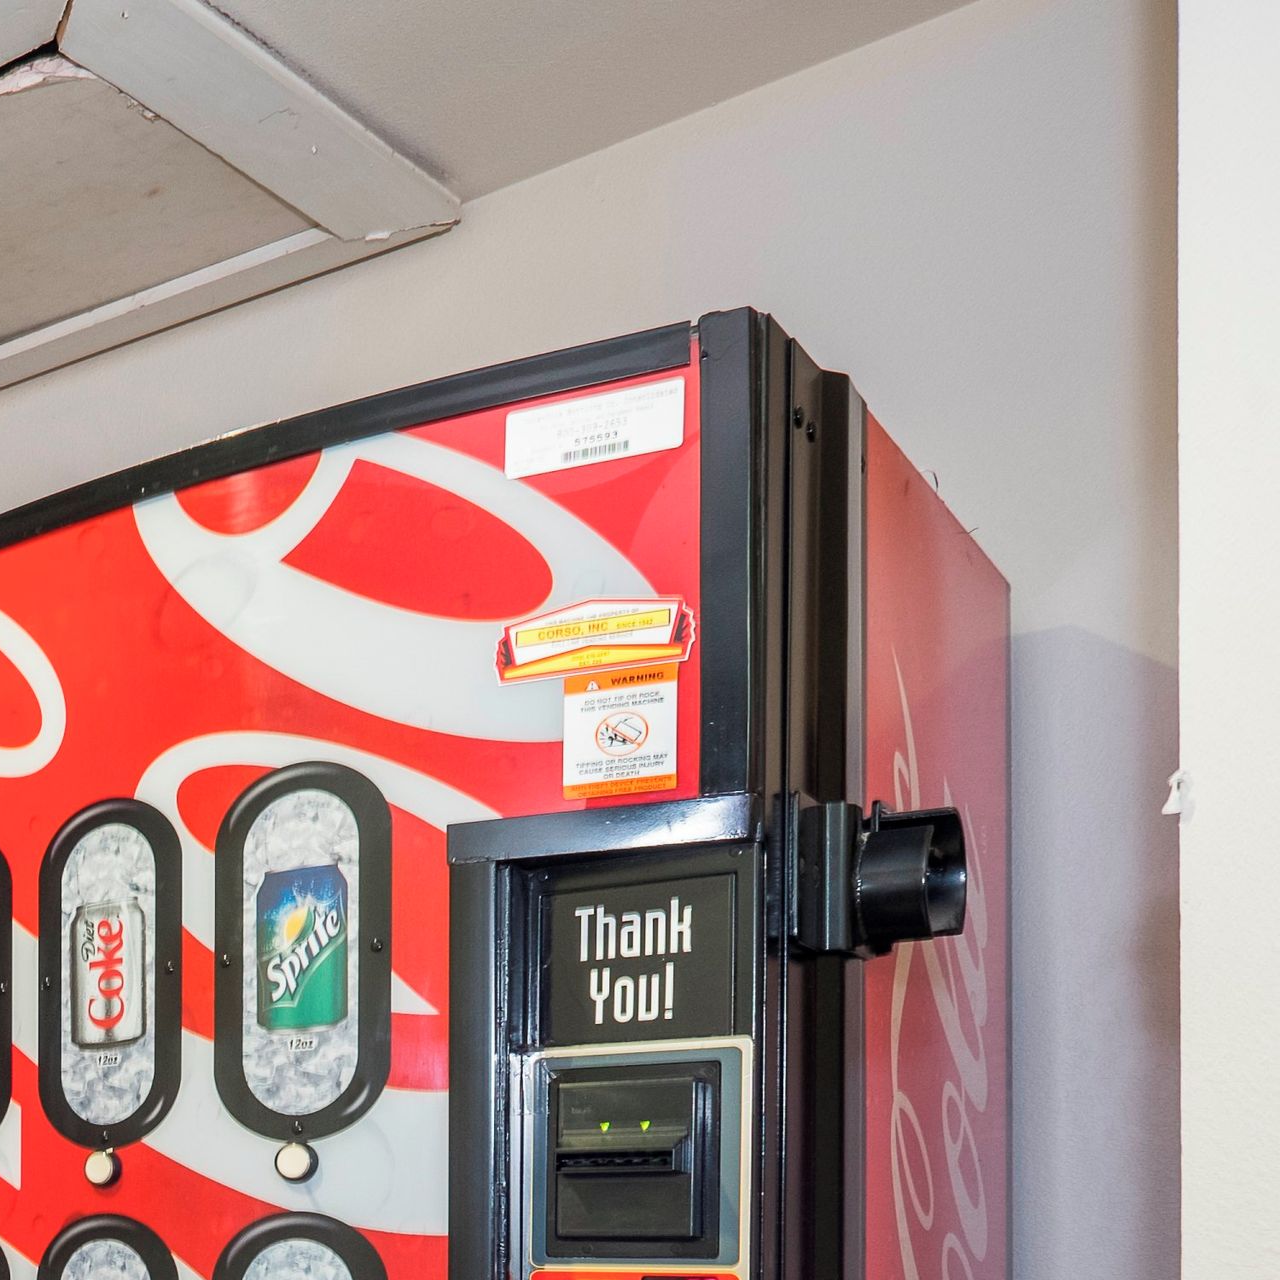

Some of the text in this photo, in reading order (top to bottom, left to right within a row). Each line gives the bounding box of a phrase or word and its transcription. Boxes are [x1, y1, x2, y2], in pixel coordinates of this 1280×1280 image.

[574, 430, 618, 446] 575593
[538, 625, 584, 641] CORSO,
[588, 621, 608, 634] INC
[611, 672, 664, 685] WARNING
[632, 698, 664, 706] MACHINE
[575, 896, 692, 962] Thank
[267, 908, 341, 1003] Sprite
[81, 919, 125, 1030] Diet Coke
[590, 961, 674, 1024] You!
[289, 1039, 313, 1050] 12oz
